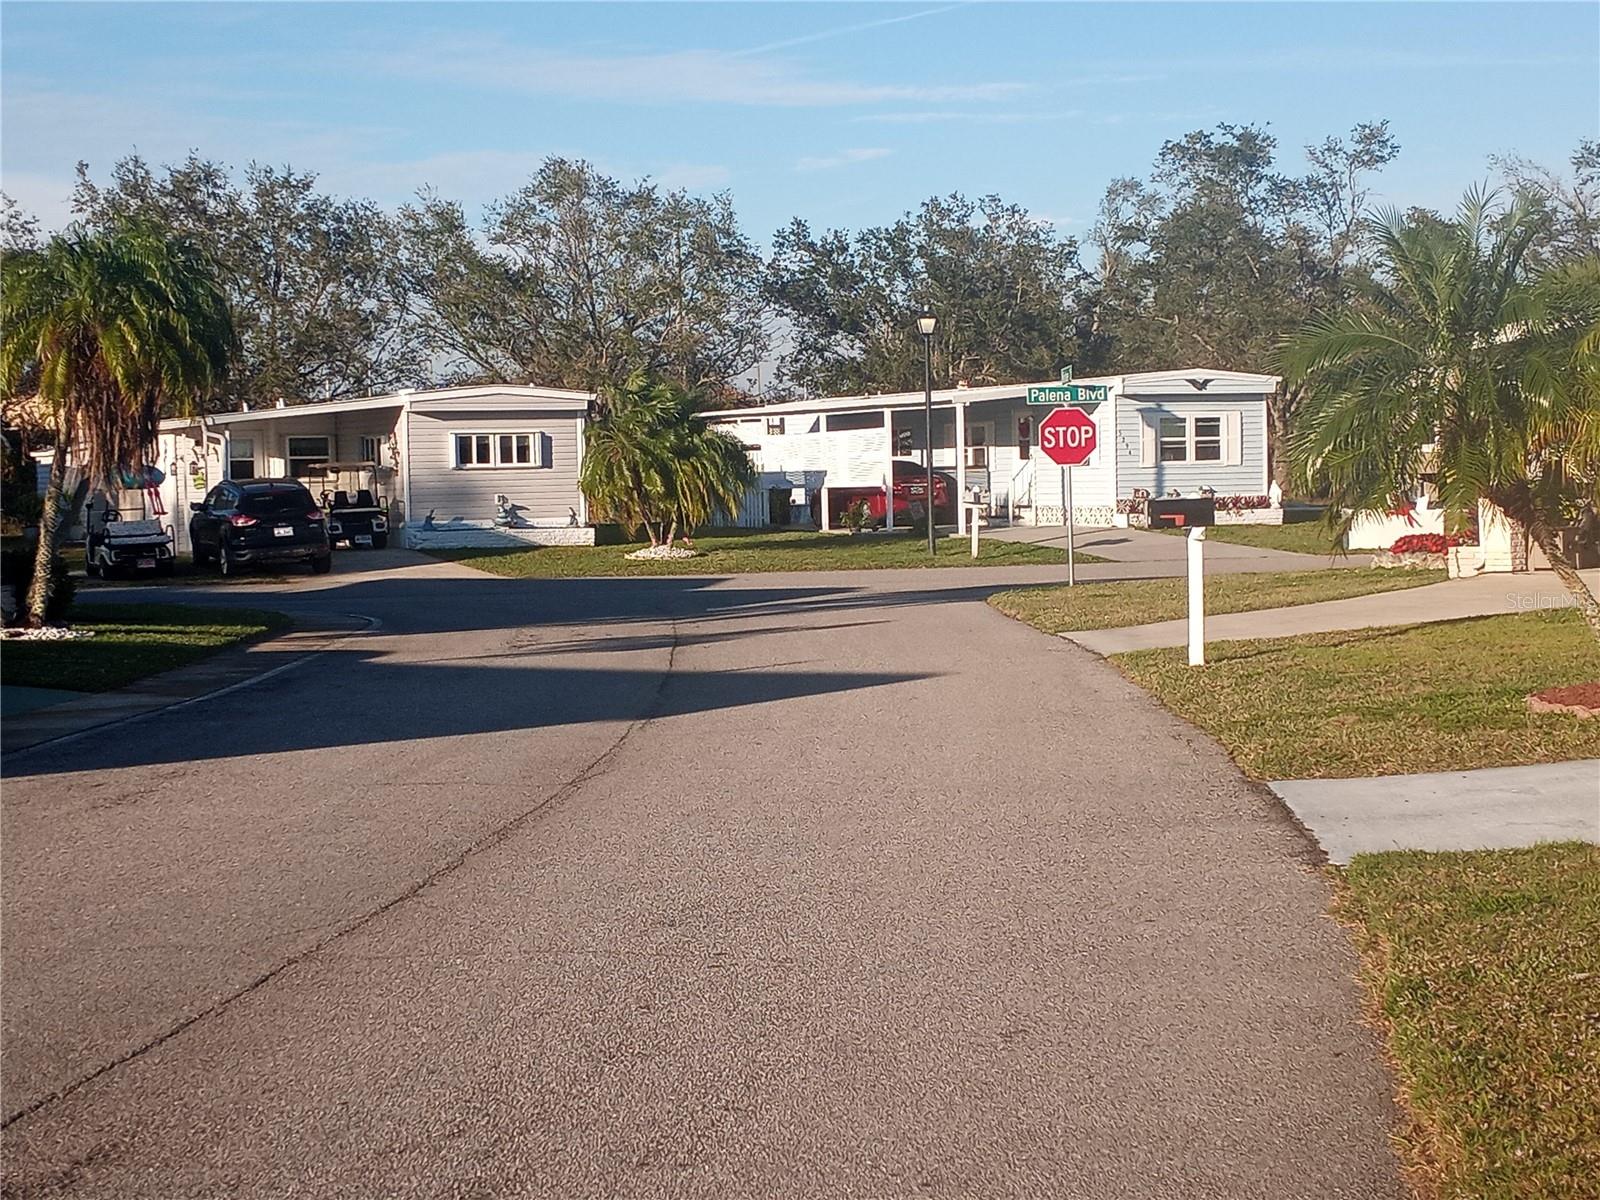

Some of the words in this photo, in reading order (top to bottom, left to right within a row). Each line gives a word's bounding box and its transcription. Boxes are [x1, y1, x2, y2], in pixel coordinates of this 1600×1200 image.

[1031, 388, 1071, 402] Palena
[1078, 387, 1105, 400] Blvd
[1043, 426, 1093, 448] STOP
